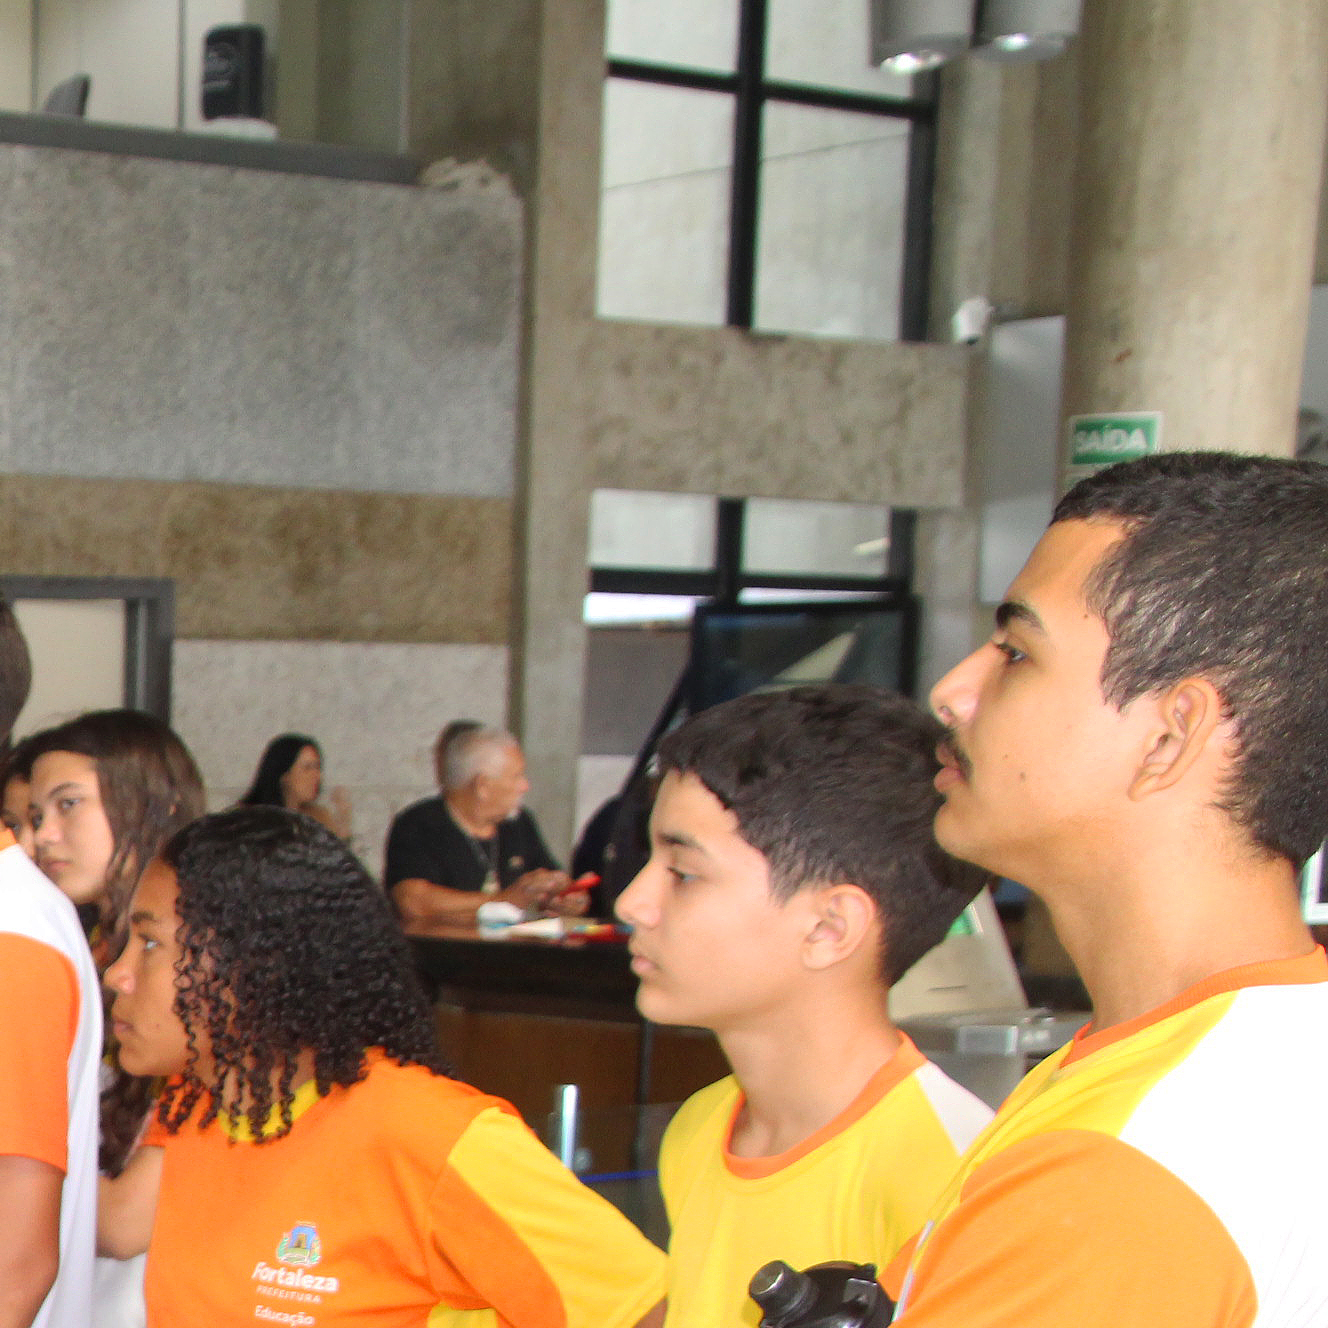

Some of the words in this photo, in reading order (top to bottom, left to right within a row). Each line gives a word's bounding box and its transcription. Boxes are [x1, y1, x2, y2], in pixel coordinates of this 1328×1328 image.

[1075, 423, 1148, 453] SAÍDA
[251, 1261, 338, 1292] Fortaleza
[256, 1285, 320, 1303] PREFEITURA
[255, 1305, 315, 1327] Educação
